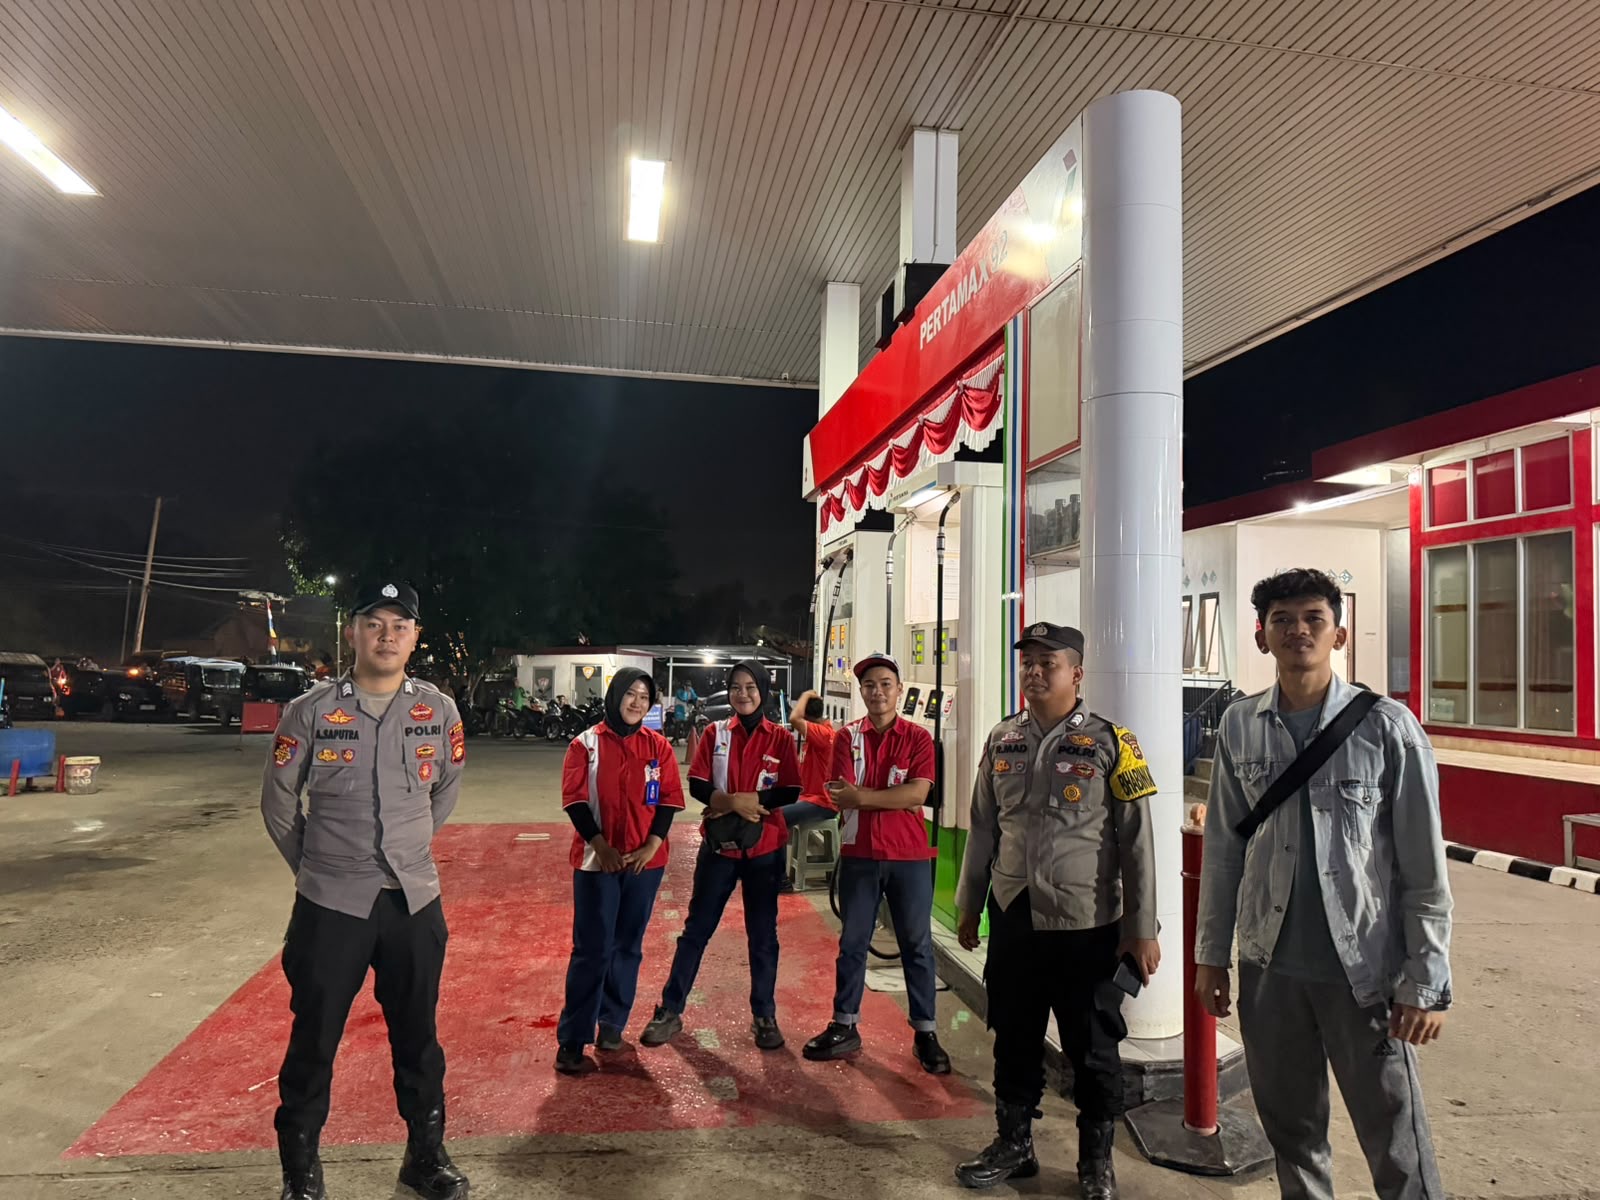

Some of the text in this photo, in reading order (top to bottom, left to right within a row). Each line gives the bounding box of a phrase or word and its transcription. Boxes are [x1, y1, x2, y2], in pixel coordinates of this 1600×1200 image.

[920, 258, 989, 351] PERTAMAX
[316, 729, 359, 741] A.SAPUTRA
[405, 725, 441, 737] POLRI
[1057, 745, 1096, 758] POLRI
